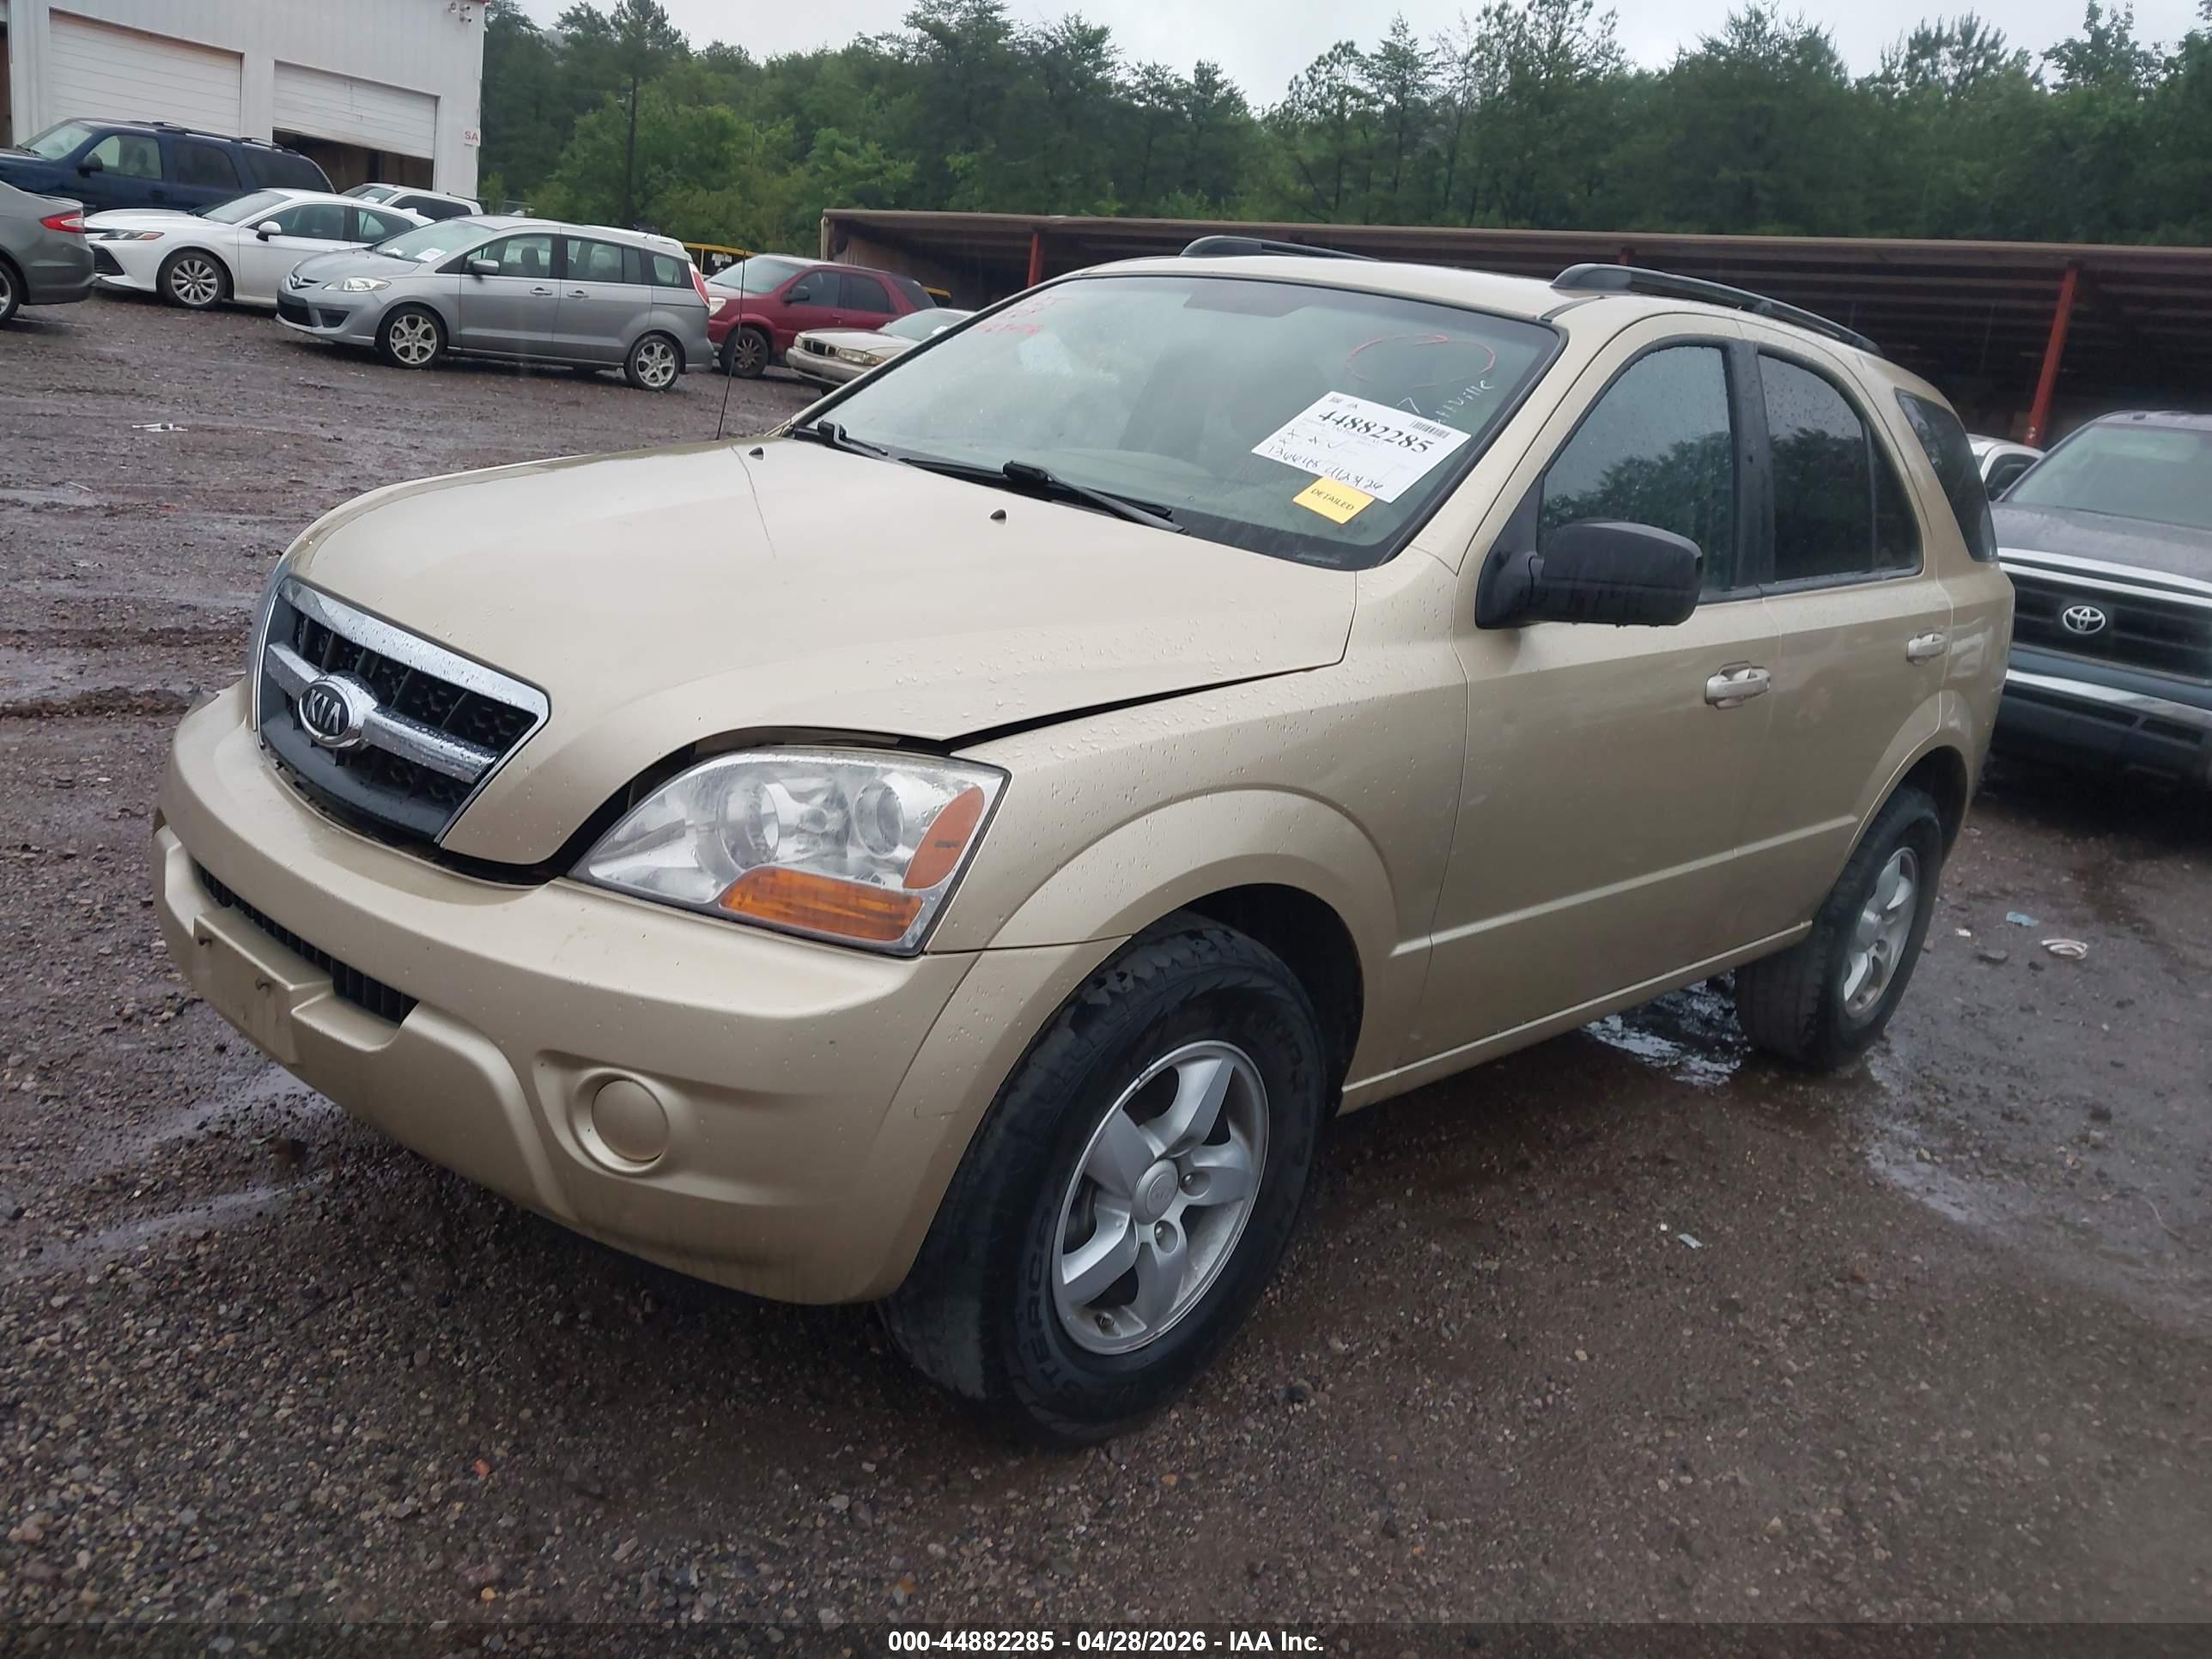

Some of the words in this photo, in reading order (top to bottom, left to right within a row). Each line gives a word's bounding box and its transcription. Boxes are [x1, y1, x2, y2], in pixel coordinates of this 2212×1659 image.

[1318, 410, 1435, 453] 44882285
[1310, 488, 1356, 512] DETAILED
[306, 688, 342, 735] KIA
